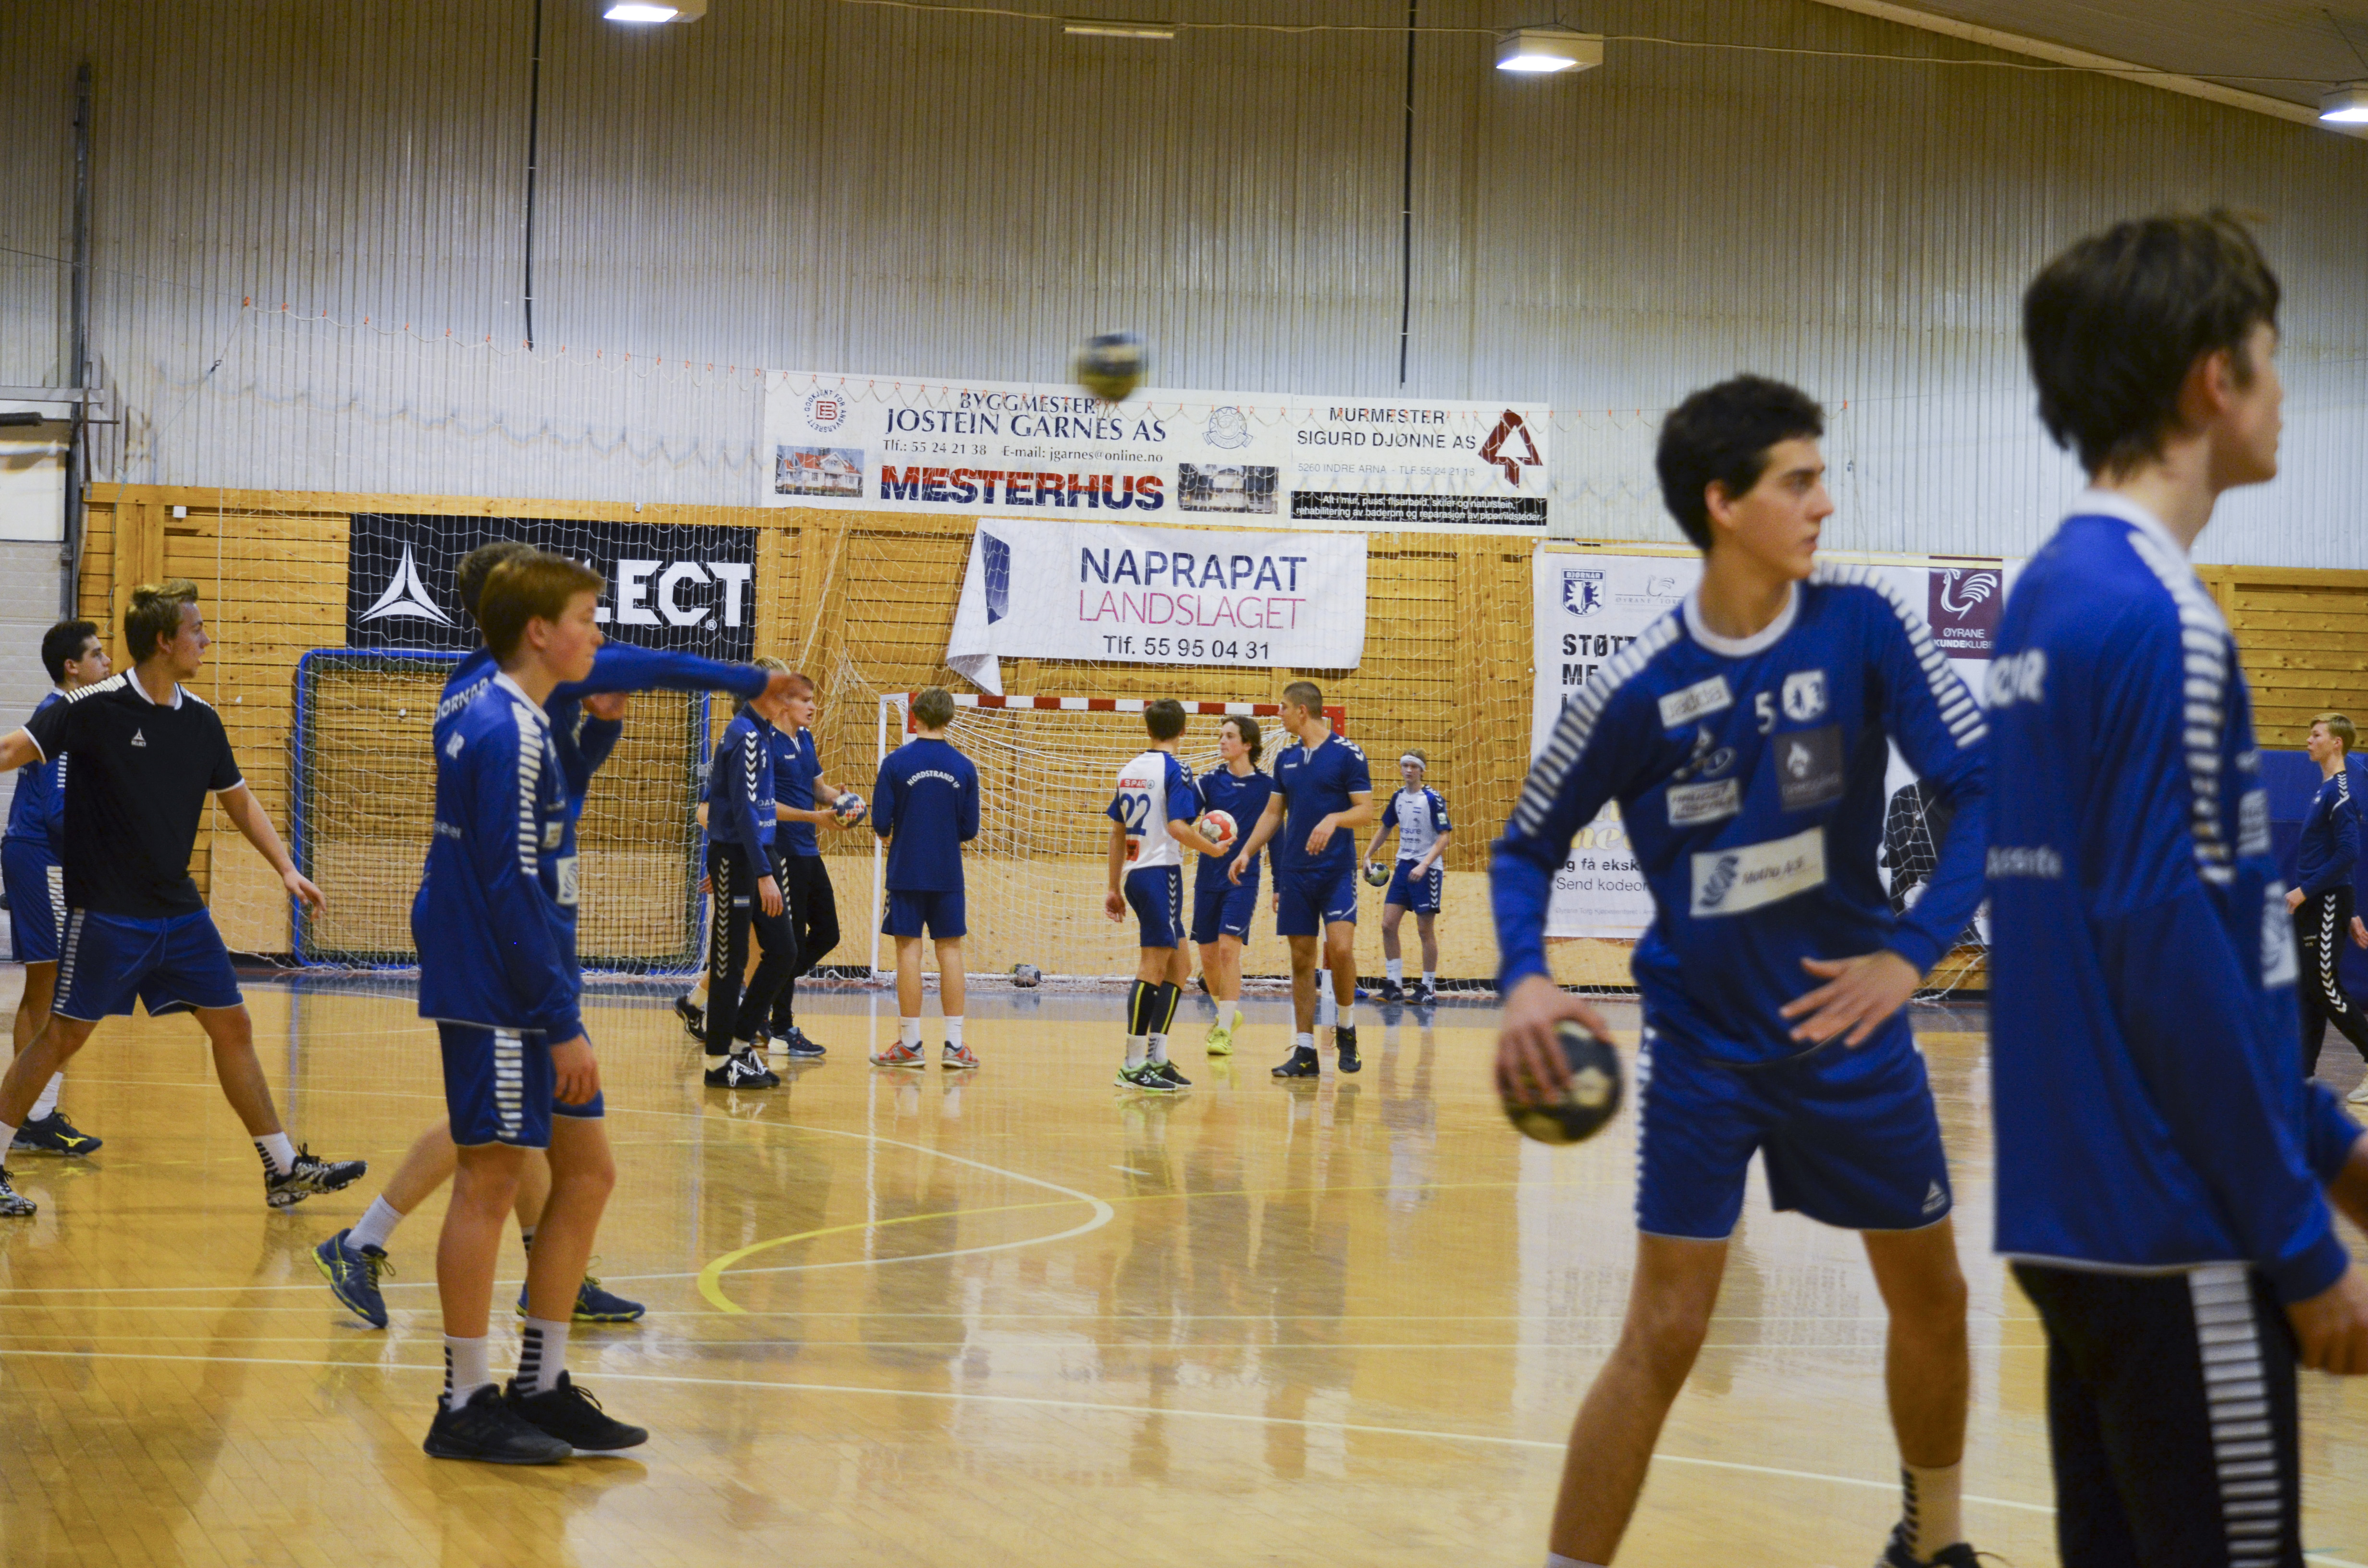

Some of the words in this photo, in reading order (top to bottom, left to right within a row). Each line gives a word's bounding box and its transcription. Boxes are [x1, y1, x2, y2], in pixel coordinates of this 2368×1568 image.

[961, 392, 1096, 414] BYGGMESTER
[886, 408, 999, 435] JOSTEIN
[1011, 414, 1122, 441] GARNES
[1133, 419, 1166, 442] AS
[1330, 407, 1444, 425] MURMESTER
[1297, 430, 1366, 446] SIGURD
[1372, 432, 1446, 448] DJØNNE
[1453, 435, 1476, 450] AS
[883, 440, 907, 452] Tlf.:
[911, 441, 926, 453] 55
[932, 442, 946, 453] 24
[951, 443, 965, 454] 21
[972, 444, 987, 455] 38
[1049, 446, 1163, 462] jgarnes@online.no
[1298, 463, 1320, 472] 5260
[1323, 464, 1355, 473] INDRE
[1359, 465, 1387, 474] ARNA
[1420, 466, 1431, 475] 55
[1434, 467, 1446, 476] 24
[1450, 468, 1459, 476] 21
[1464, 468, 1475, 477] 16
[881, 466, 1164, 511] MESTERHUS
[1296, 506, 1351, 517] rehabilitering
[1365, 508, 1404, 517] baderom
[1406, 510, 1418, 518] og
[1419, 510, 1465, 520] reparasjon
[1457, 501, 1468, 509] og
[1081, 547, 1307, 591] NAPRAPAT
[1079, 590, 1307, 629] LANDSLAGET
[1943, 627, 1985, 638] ØYRANE
[1103, 635, 1135, 655] Tlf.
[1144, 637, 1170, 656] 55
[1177, 638, 1205, 658] 95
[1212, 640, 1238, 659] 04
[1246, 641, 1269, 660] 31
[907, 770, 955, 786] NORDSTRAND
[1124, 779, 1147, 788] SPAR
[1119, 793, 1151, 836] 22
[1581, 857, 1596, 870] få
[1556, 877, 1593, 891] Send
